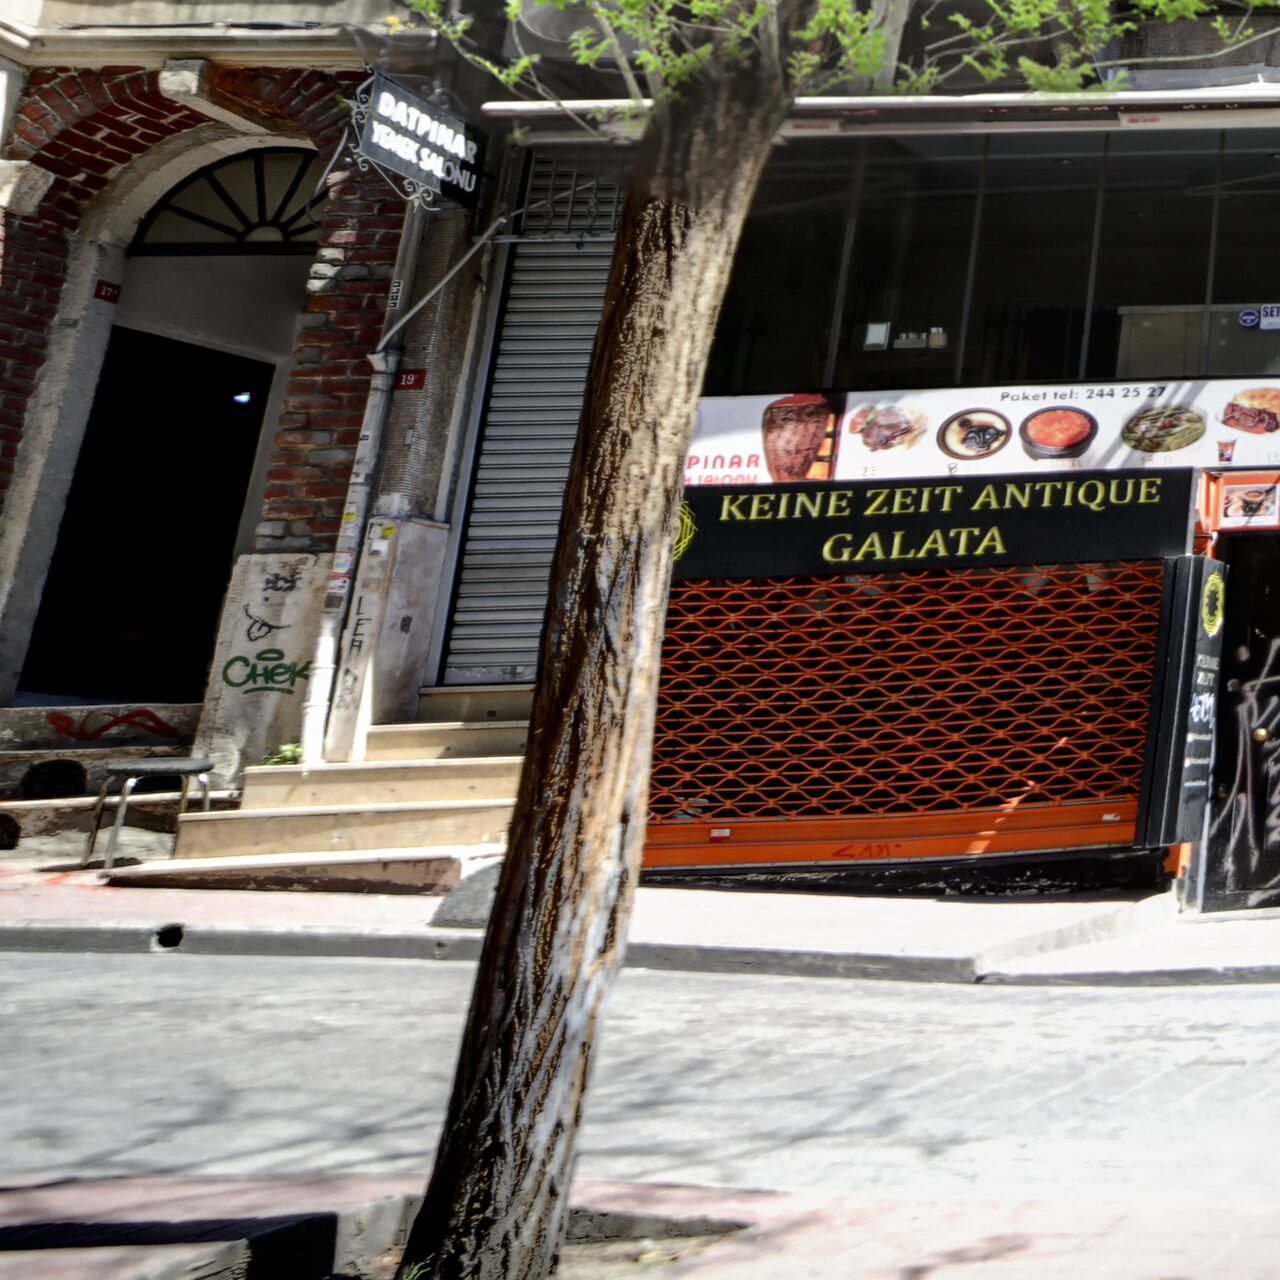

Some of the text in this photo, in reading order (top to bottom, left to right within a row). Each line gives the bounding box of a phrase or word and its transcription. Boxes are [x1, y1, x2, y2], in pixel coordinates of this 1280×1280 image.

[377, 91, 477, 164] DATPINAR
[371, 120, 477, 192] YEMEK SALONU
[400, 374, 415, 385] 19
[1000, 386, 1166, 402] Paket tel: 244 25 27
[686, 453, 760, 469] PINAR
[720, 477, 1163, 521] KEINE ZEIT ANTIQUE
[822, 525, 1007, 563] GALATA
